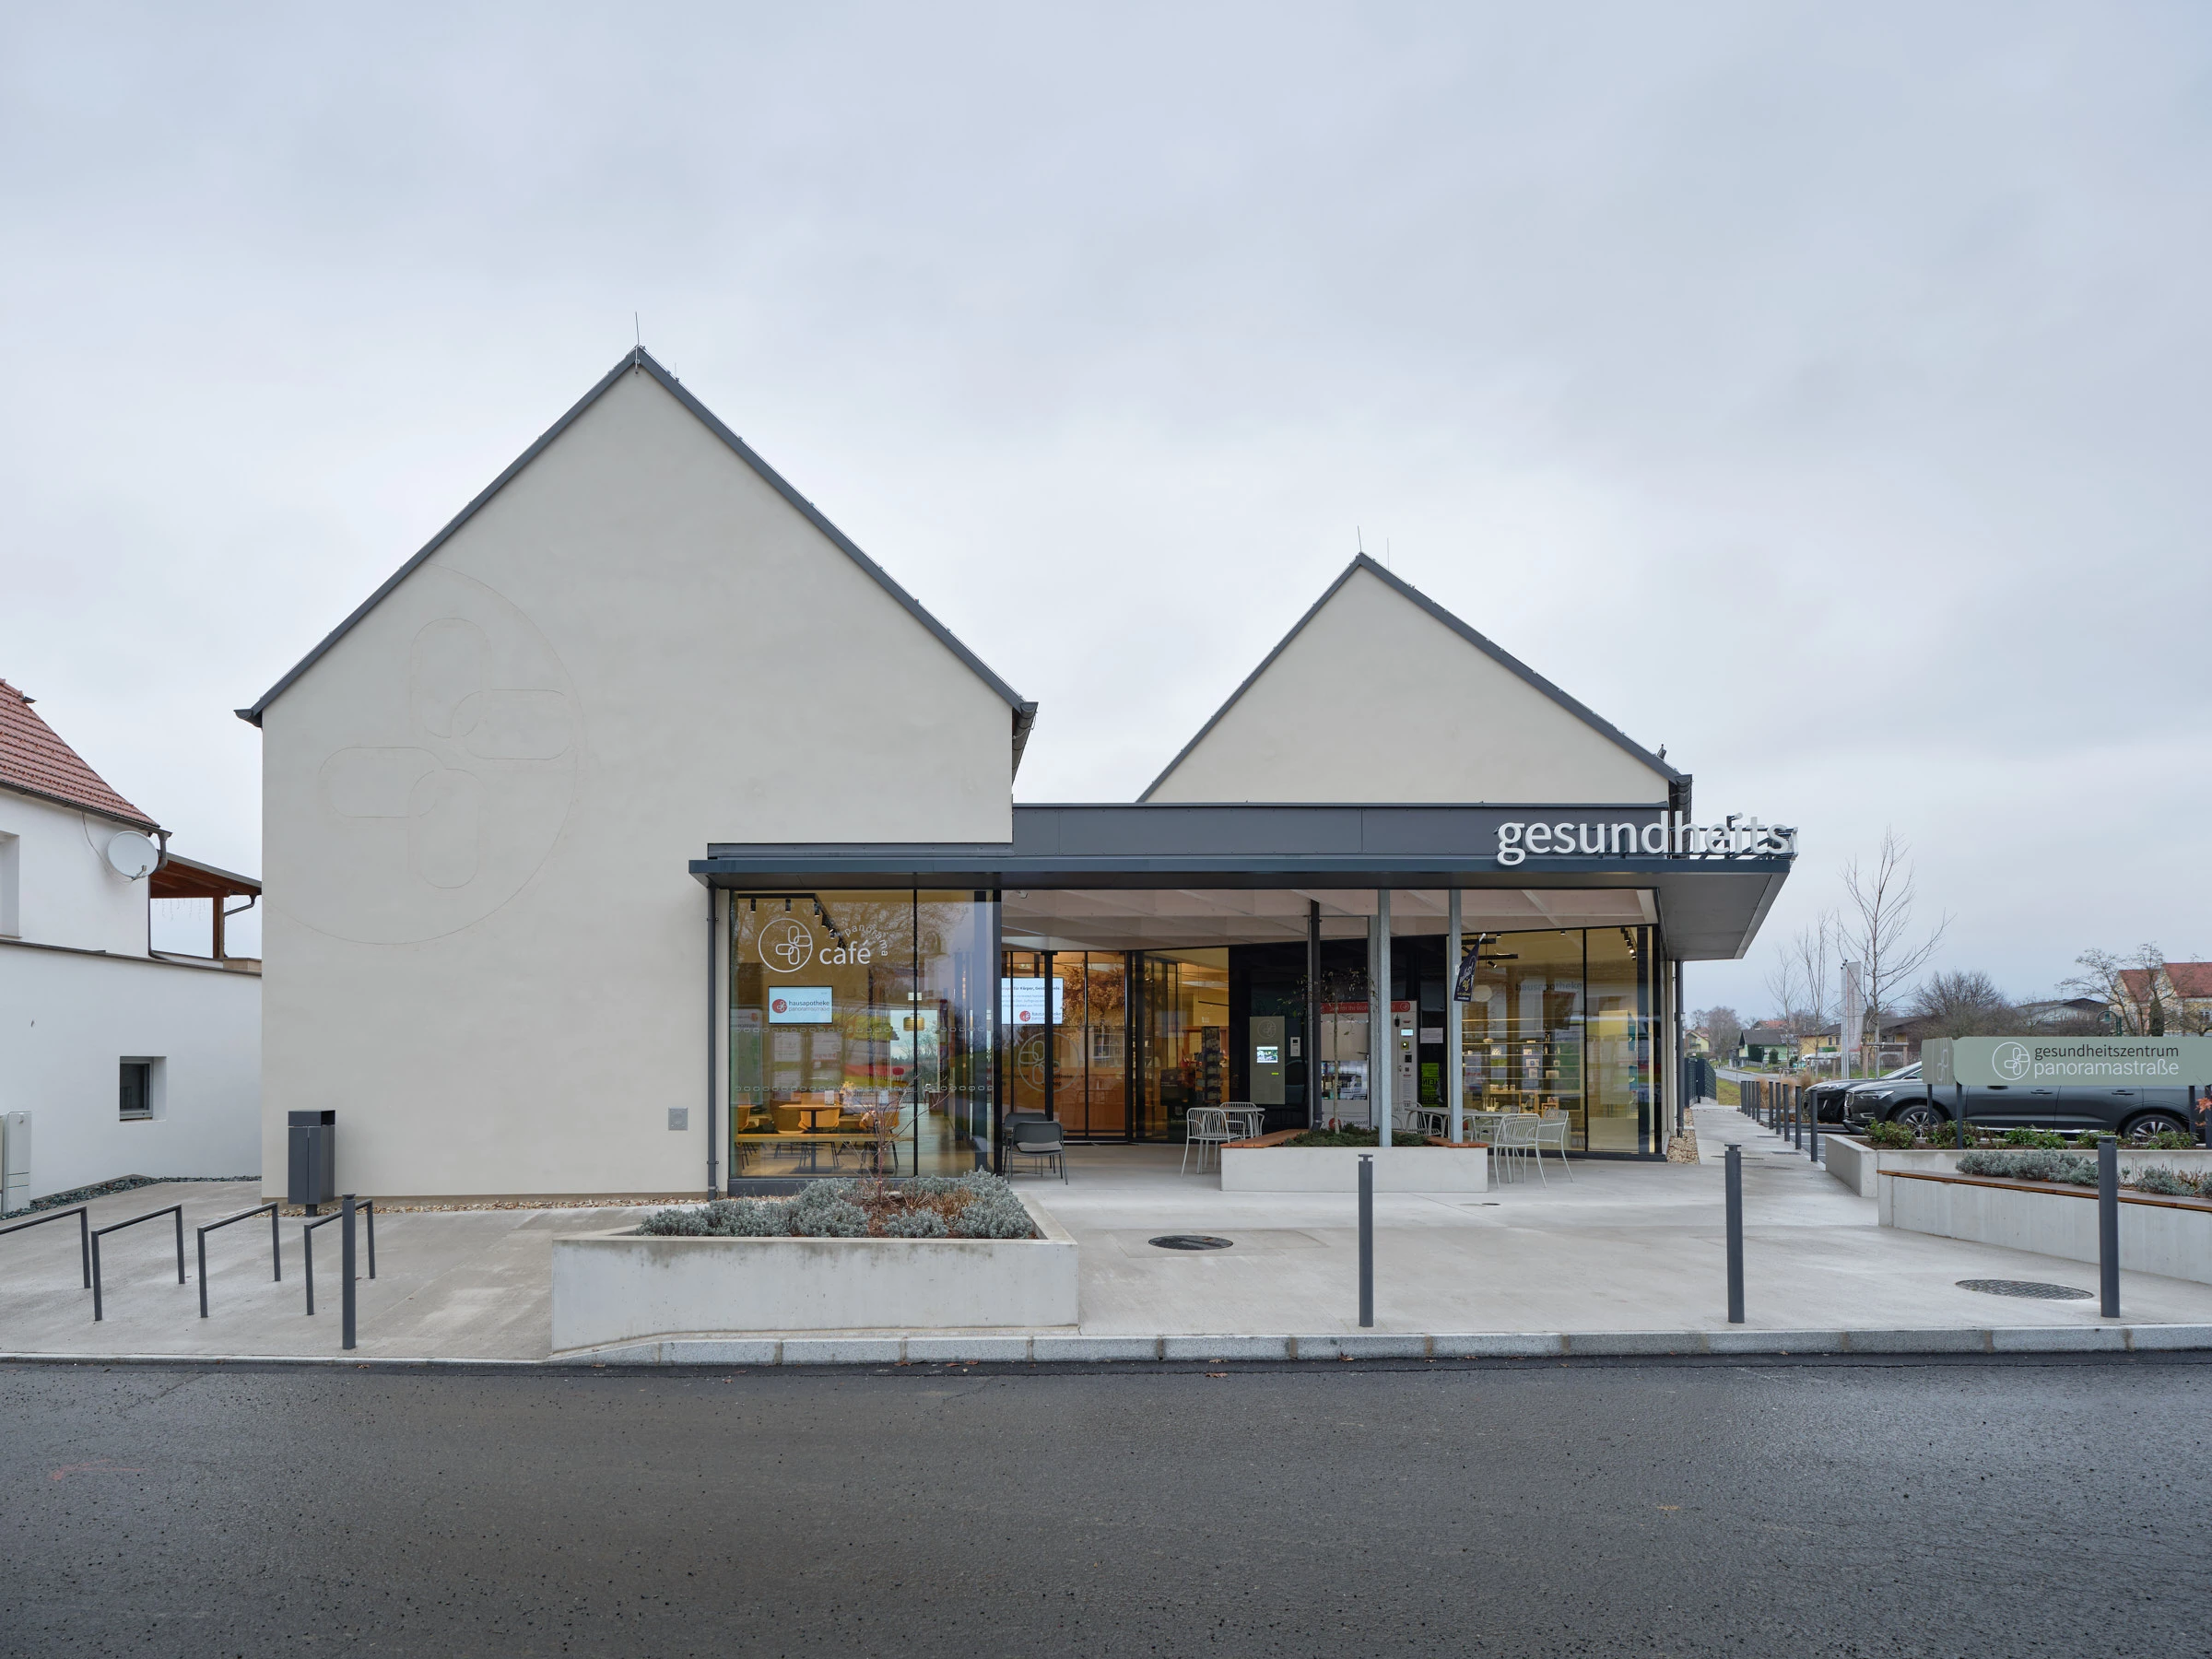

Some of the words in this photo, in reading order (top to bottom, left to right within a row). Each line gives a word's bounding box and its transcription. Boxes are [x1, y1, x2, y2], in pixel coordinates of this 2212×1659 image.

[1497, 810, 1789, 865] gesundheits
[819, 939, 871, 964] café
[844, 924, 888, 957] panorama
[2034, 1044, 2180, 1060] gesundheitszentrum
[2034, 1058, 2180, 1078] panoramastraße
